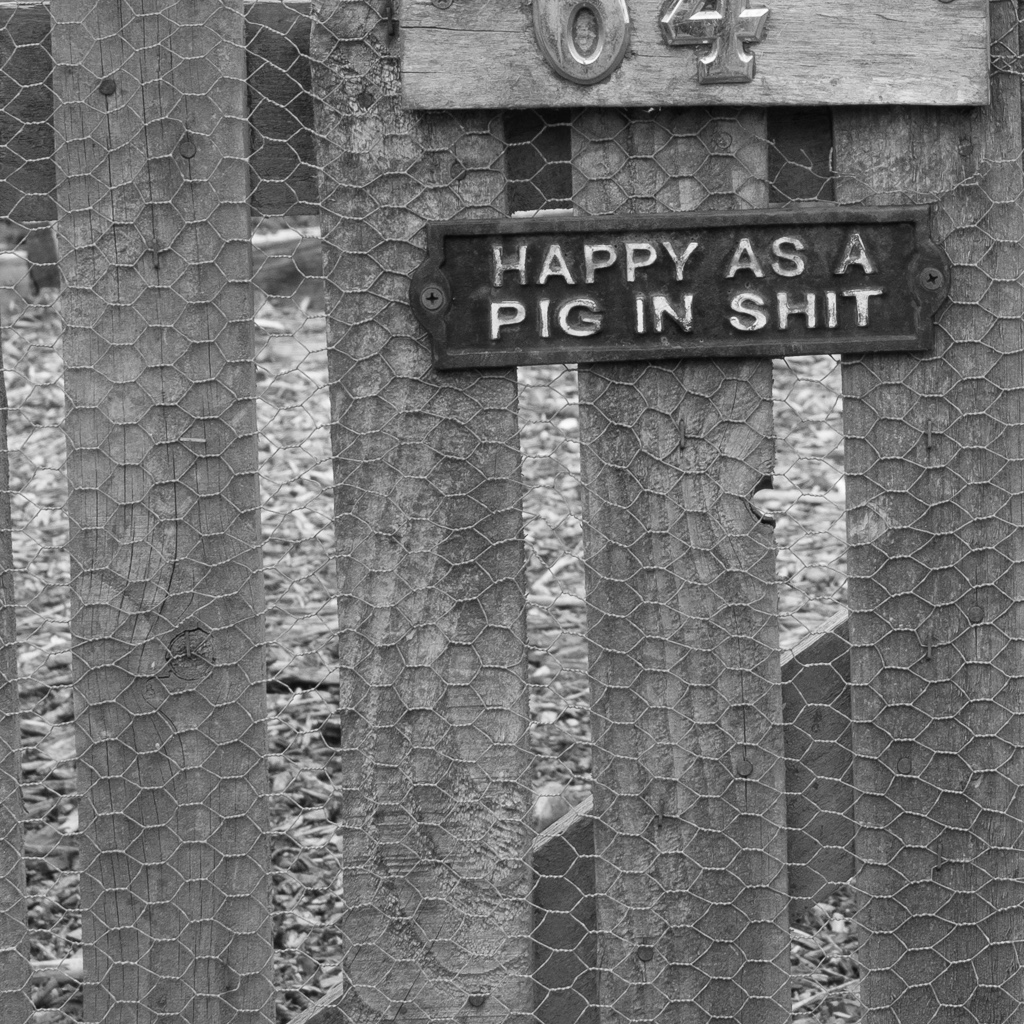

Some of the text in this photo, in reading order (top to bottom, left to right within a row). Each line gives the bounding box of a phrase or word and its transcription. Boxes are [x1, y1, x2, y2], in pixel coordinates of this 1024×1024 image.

[491, 233, 875, 287] HAPPY AS A
[490, 288, 883, 339] PIG IN SHIT
